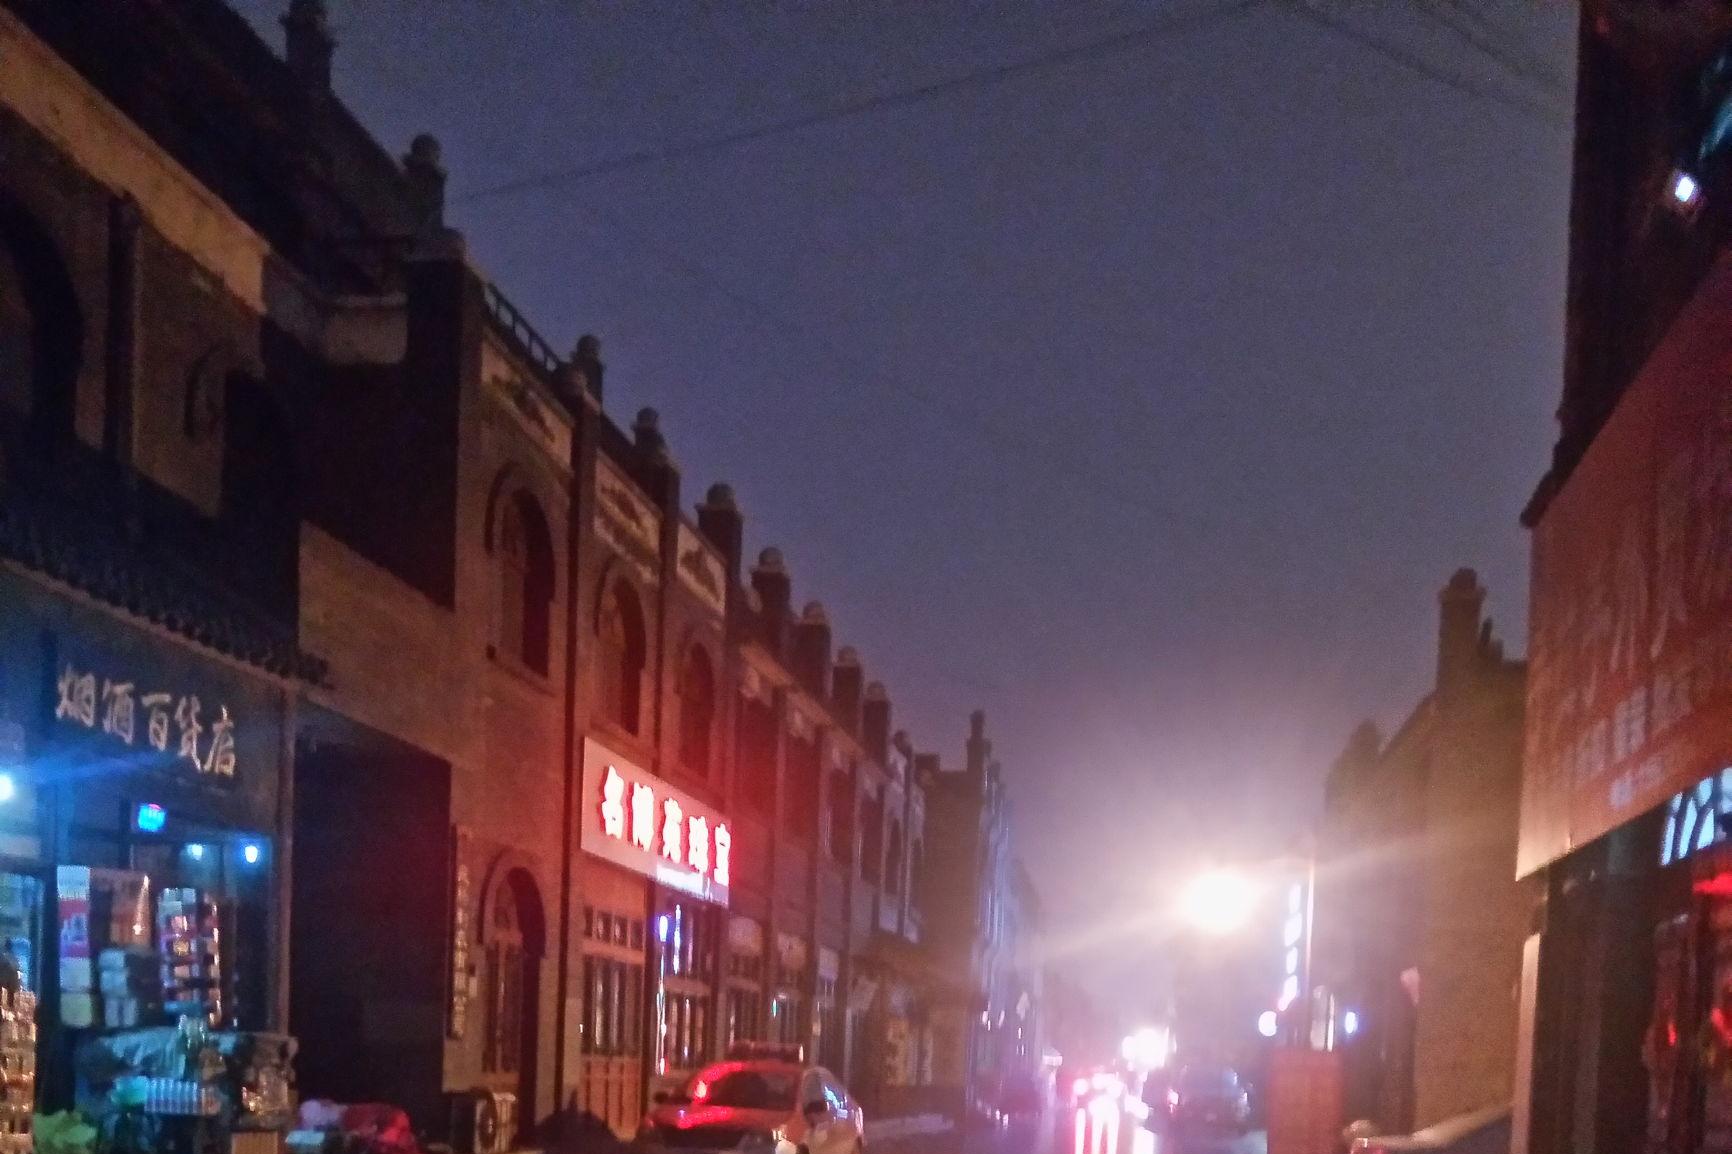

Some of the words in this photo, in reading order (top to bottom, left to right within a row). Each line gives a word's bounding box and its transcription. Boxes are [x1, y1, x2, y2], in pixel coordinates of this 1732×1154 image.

[55, 664, 237, 777] 烟酒百货店
